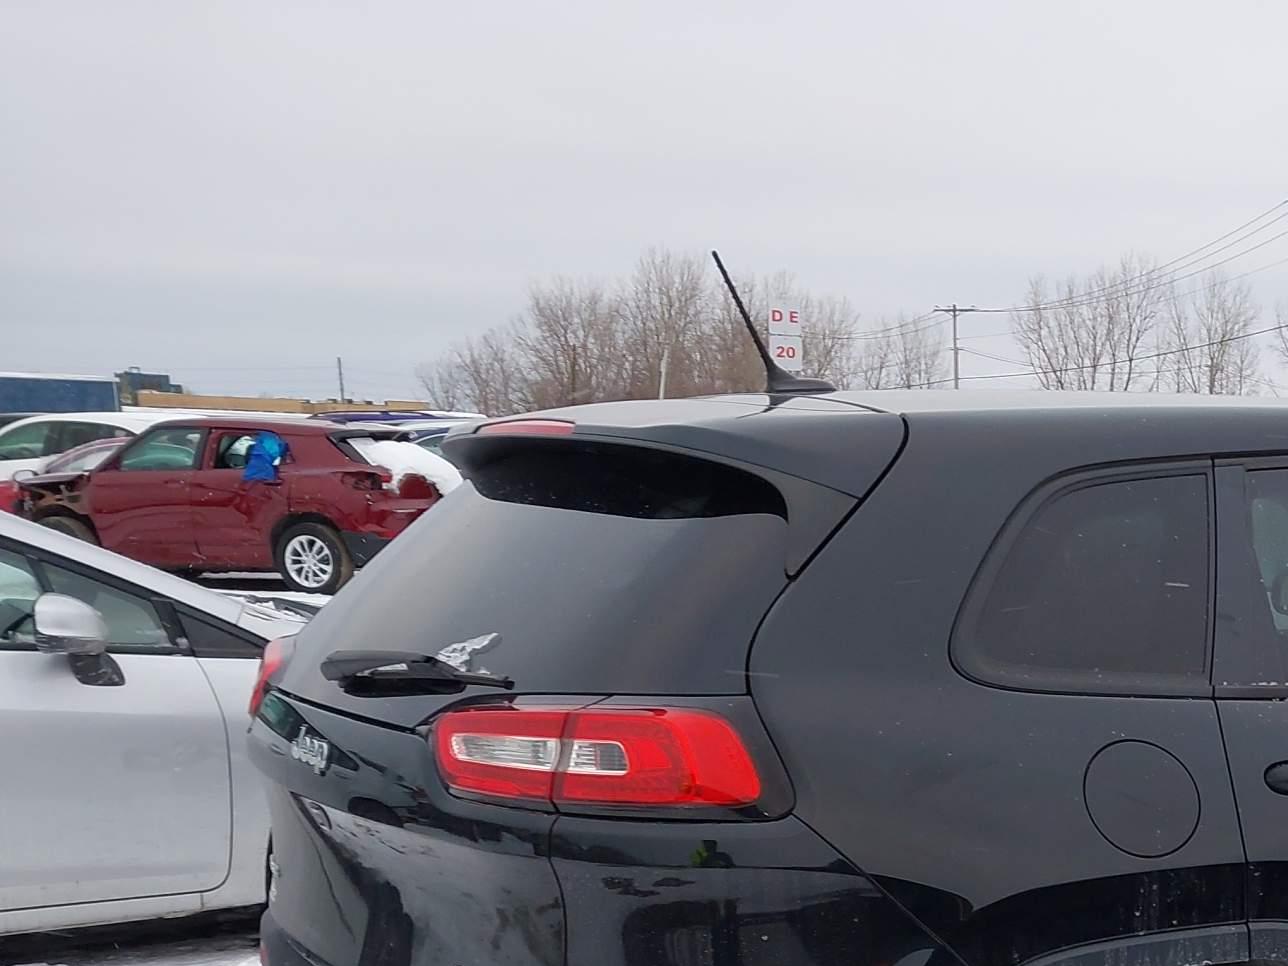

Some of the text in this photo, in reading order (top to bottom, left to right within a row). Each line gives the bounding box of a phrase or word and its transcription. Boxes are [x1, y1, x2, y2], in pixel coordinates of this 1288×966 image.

[771, 309, 799, 323] D E
[776, 346, 796, 359] 20
[291, 724, 328, 775] Jeep
